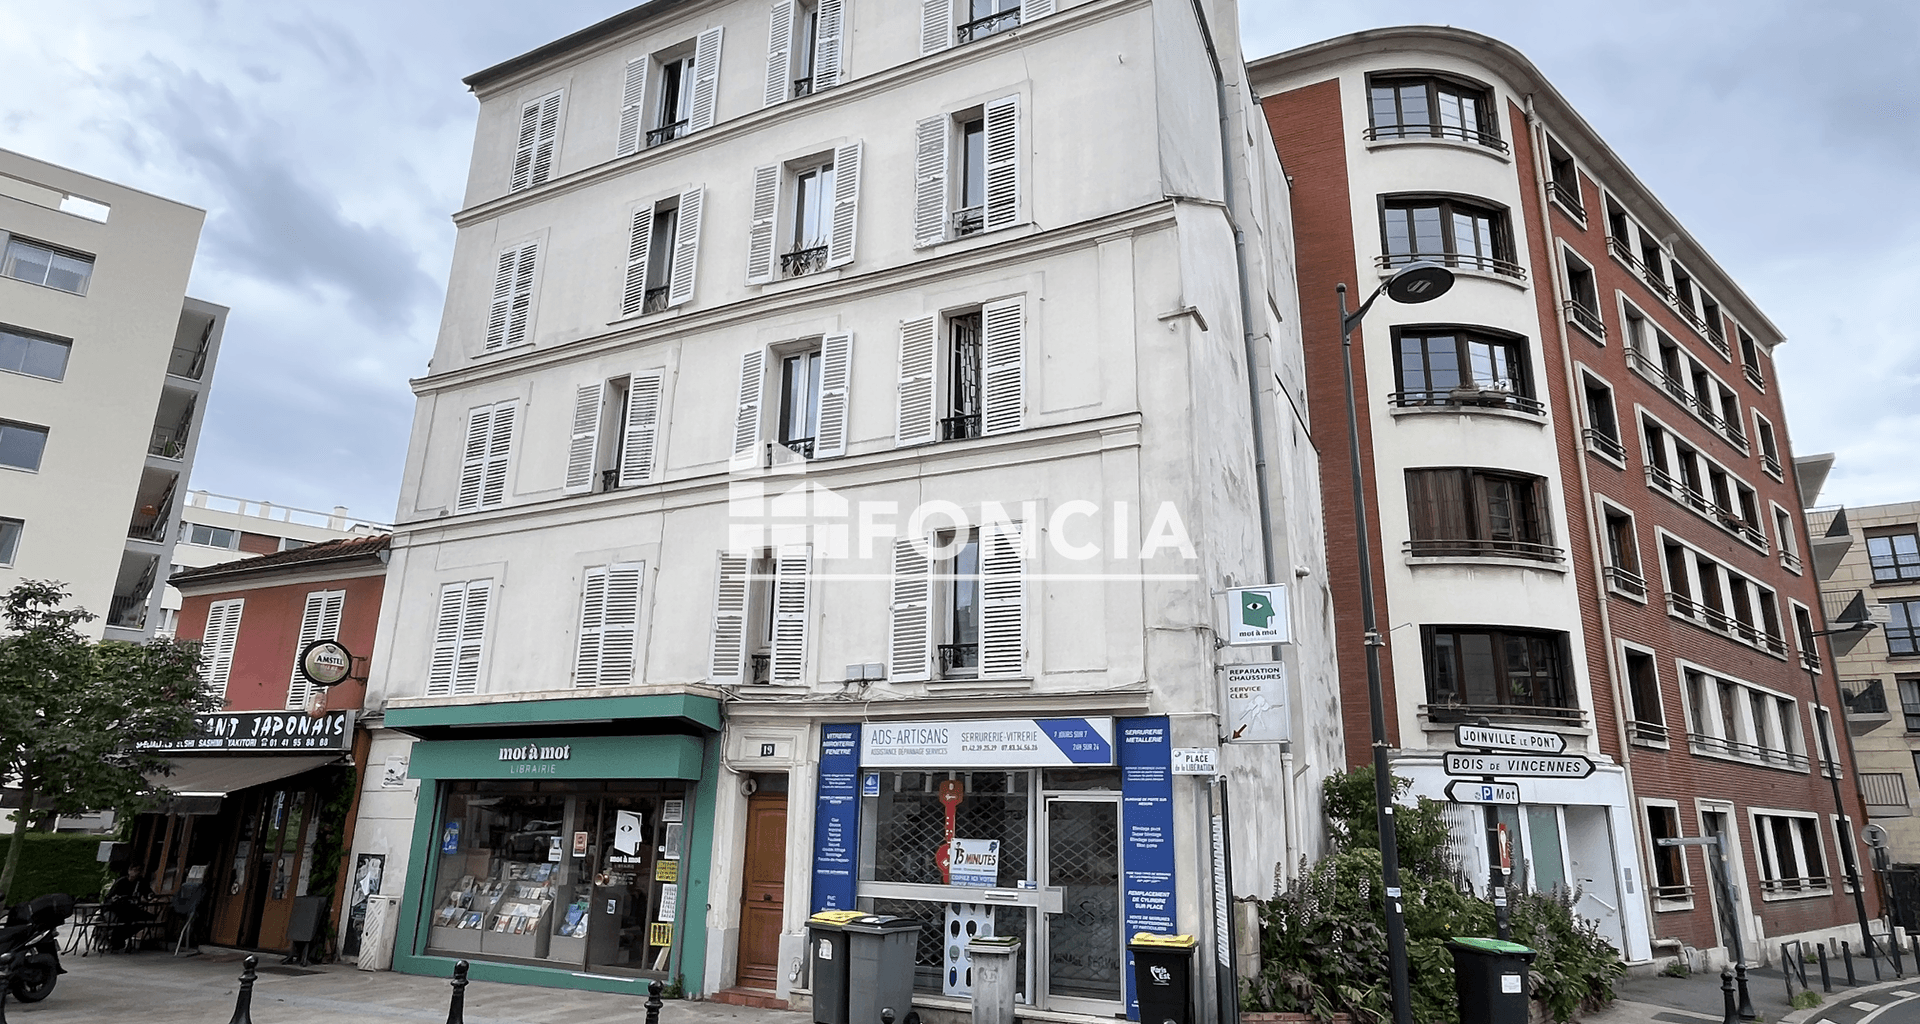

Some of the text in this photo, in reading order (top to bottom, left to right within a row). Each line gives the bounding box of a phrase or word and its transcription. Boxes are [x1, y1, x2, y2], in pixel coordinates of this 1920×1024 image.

[316, 655, 343, 665] AMSTEL
[1229, 667, 1280, 675] REPARATION
[251, 714, 345, 737] JAPONAIS
[871, 728, 949, 745] ADS-ARTISANS
[961, 731, 1038, 742] SERRURERIE-VITRERIE
[1463, 730, 1555, 748] JOINVILLE LE PONT
[198, 738, 223, 748] SASHIMI
[228, 738, 257, 747] YAKITORI
[269, 738, 278, 747] 01
[281, 738, 289, 747] 41
[499, 743, 570, 760] mot à mot
[763, 744, 773, 755] 19
[1185, 754, 1209, 763] PLACE
[510, 764, 556, 774] LIBRAIRIE
[1452, 758, 1581, 773] BOIS DE VINCENNES
[1496, 788, 1515, 800] Mot
[965, 854, 996, 866] MINUTES
